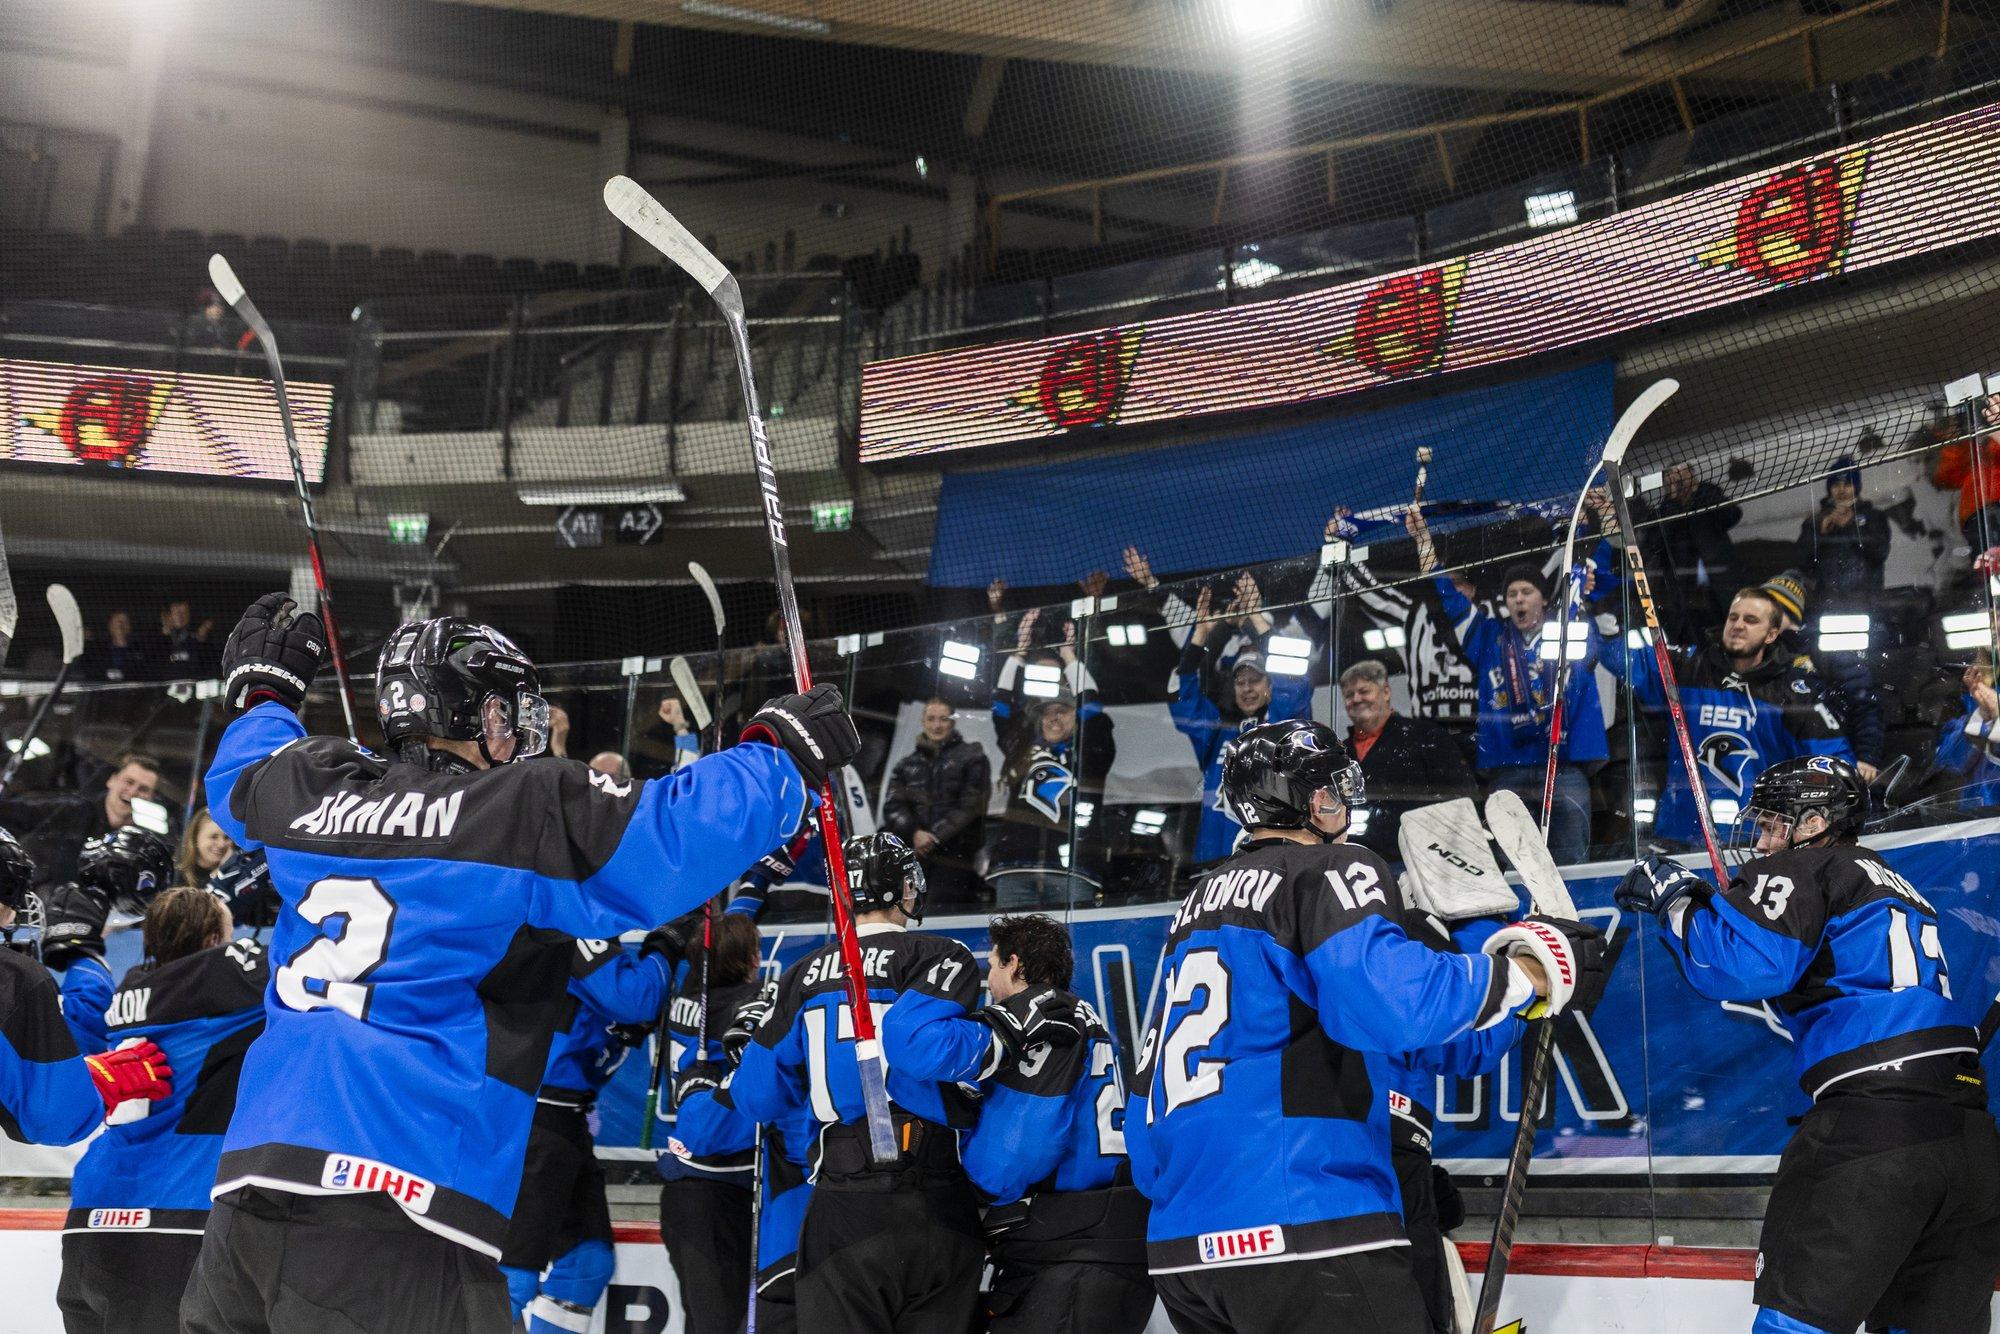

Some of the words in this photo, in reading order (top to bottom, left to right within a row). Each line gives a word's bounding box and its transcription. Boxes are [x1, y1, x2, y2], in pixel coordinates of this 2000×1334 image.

[620, 510, 651, 531] A2
[1626, 545, 1660, 628] CCM
[390, 680, 408, 709] 2
[1801, 791, 1829, 799] CCM
[289, 790, 465, 839] AHMAN
[1237, 802, 1261, 824] 12
[1427, 842, 1485, 877] CCM
[848, 869, 864, 888] 17
[1324, 861, 1388, 911] 12
[1749, 873, 1795, 921] 13
[276, 875, 395, 1022] 2
[803, 947, 896, 987] SILRE
[927, 957, 963, 992] 17
[354, 1163, 425, 1203] IIHF
[103, 1210, 145, 1226] IIHF
[1217, 1229, 1275, 1257] IIHF
